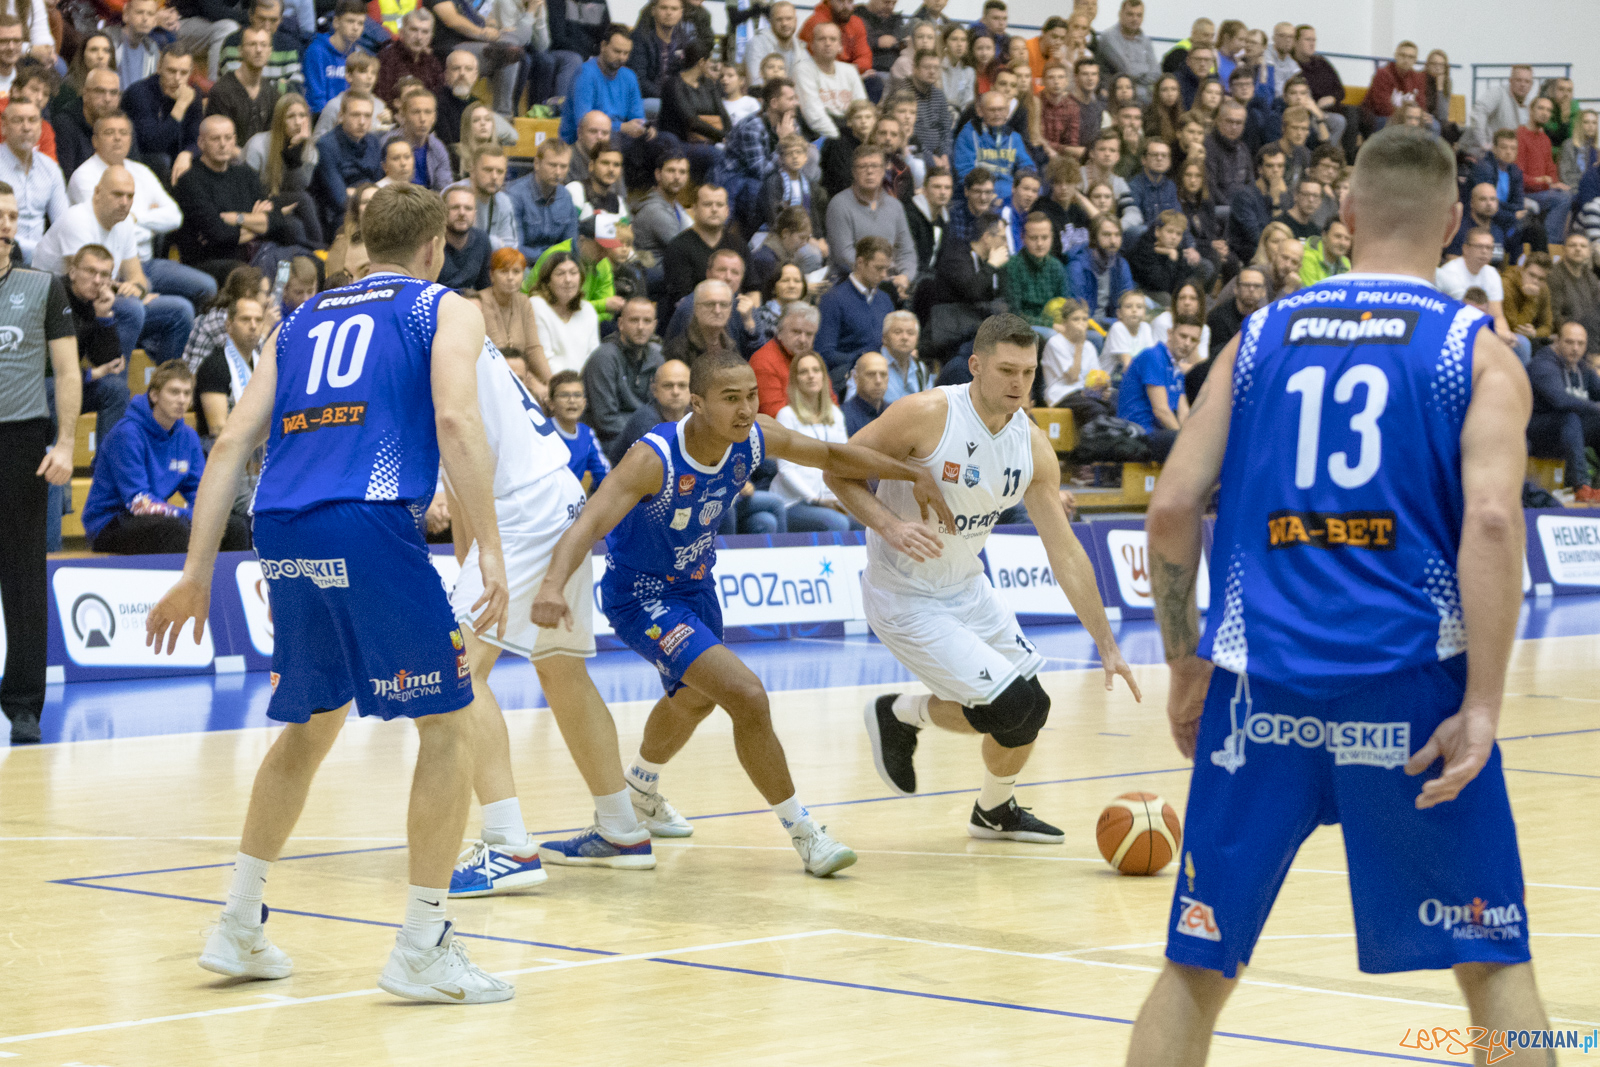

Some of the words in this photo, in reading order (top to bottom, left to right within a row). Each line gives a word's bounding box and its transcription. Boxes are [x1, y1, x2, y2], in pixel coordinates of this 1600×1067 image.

[1277, 288, 1348, 312] POGOŃ
[1355, 291, 1448, 315] PRUDNIK
[306, 313, 375, 396] 10
[282, 405, 365, 435] WA-BET
[1285, 363, 1390, 490] 13
[1268, 515, 1393, 546] WA-BET
[999, 566, 1059, 588] BIOFA
[387, 685, 442, 702] MEDYCYNA
[1248, 714, 1409, 751] OPOLSKIE
